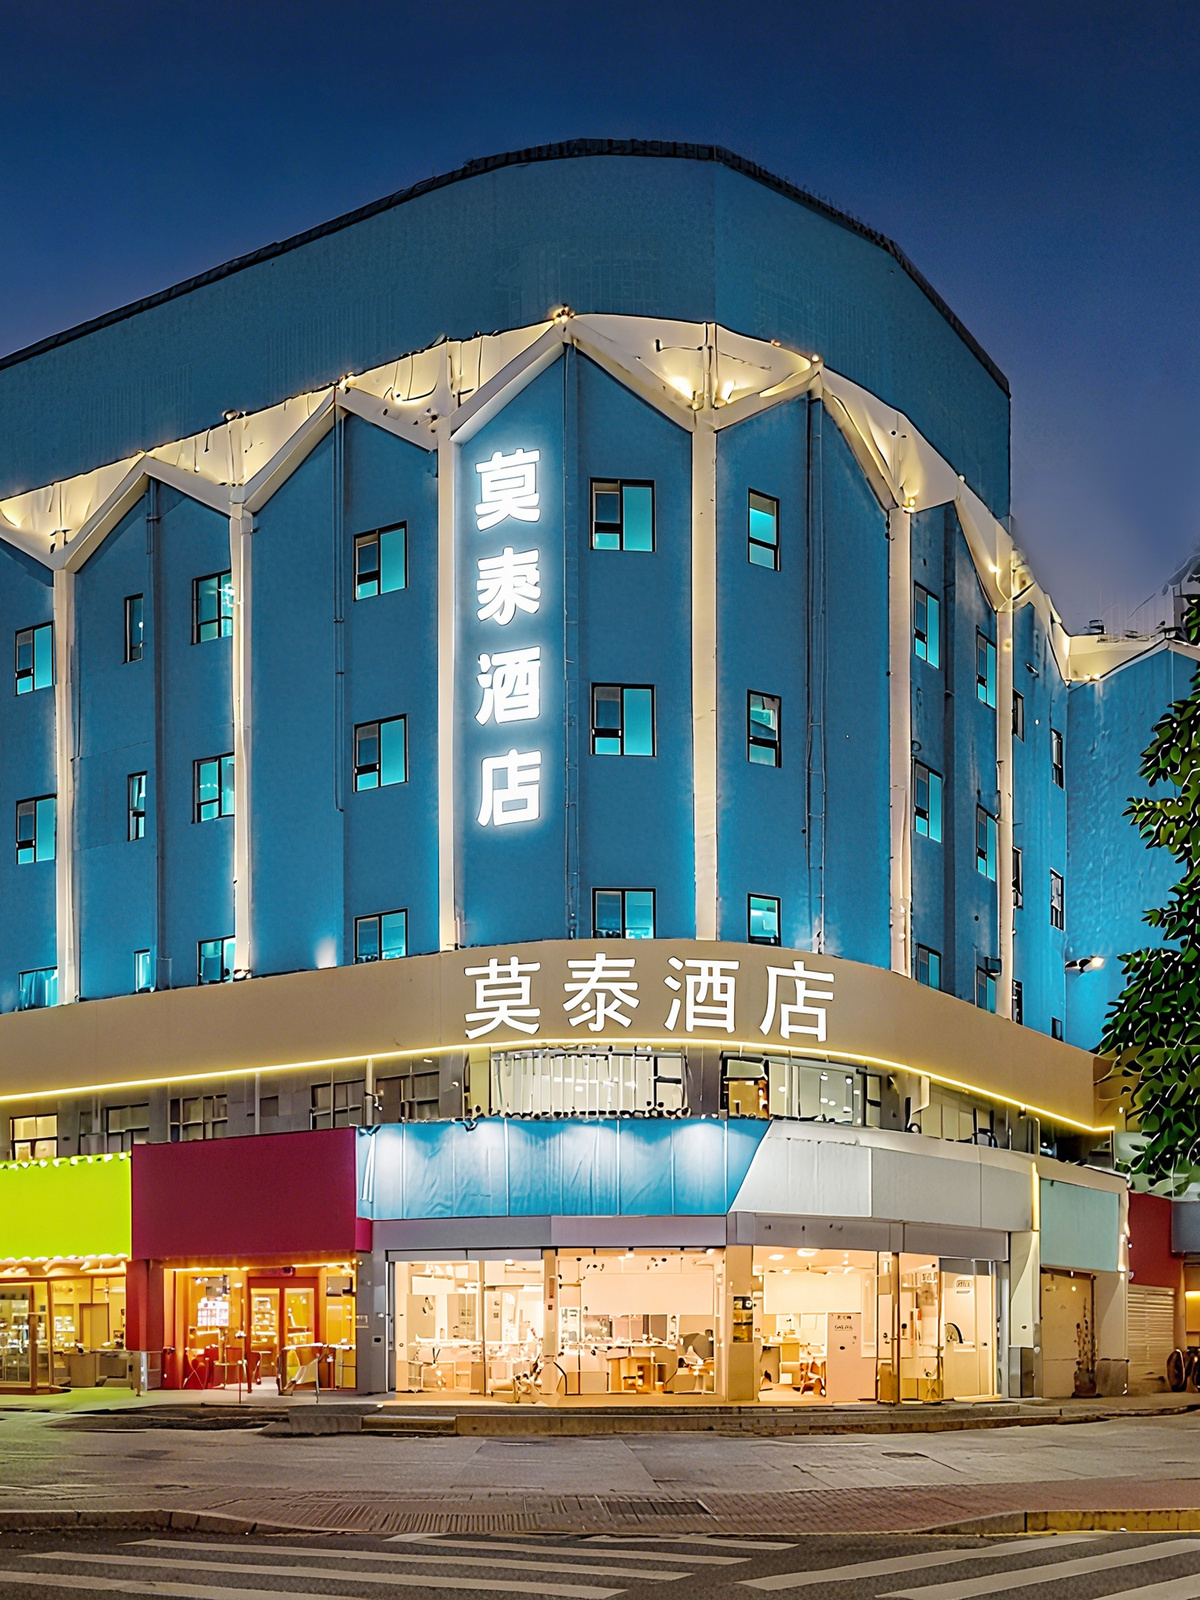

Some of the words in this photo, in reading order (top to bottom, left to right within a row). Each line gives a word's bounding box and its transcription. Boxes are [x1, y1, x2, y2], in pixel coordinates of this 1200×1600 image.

[475, 448, 541, 827] 莫泰酒店
[464, 952, 835, 1042] 莫泰酒店
